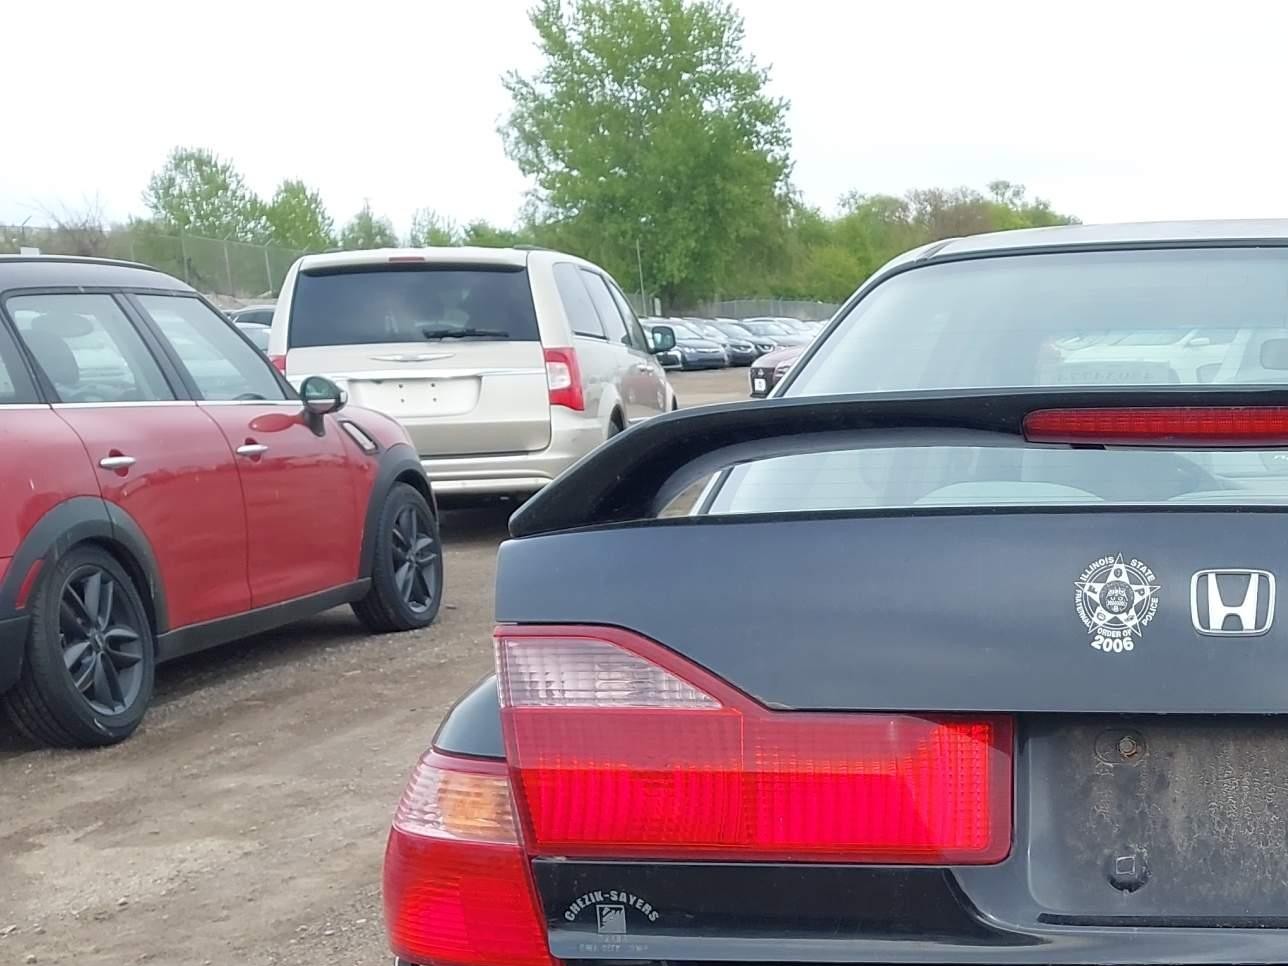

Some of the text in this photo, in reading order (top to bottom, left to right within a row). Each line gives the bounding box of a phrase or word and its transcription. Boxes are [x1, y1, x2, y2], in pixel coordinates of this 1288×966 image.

[1079, 556, 1156, 583] ILLINOIS STATE
[1074, 589, 1159, 638] FRATERNAL ORDER OF POLICE
[1090, 635, 1135, 653] 2006
[564, 889, 660, 922] CHEZIK-SAYERS
